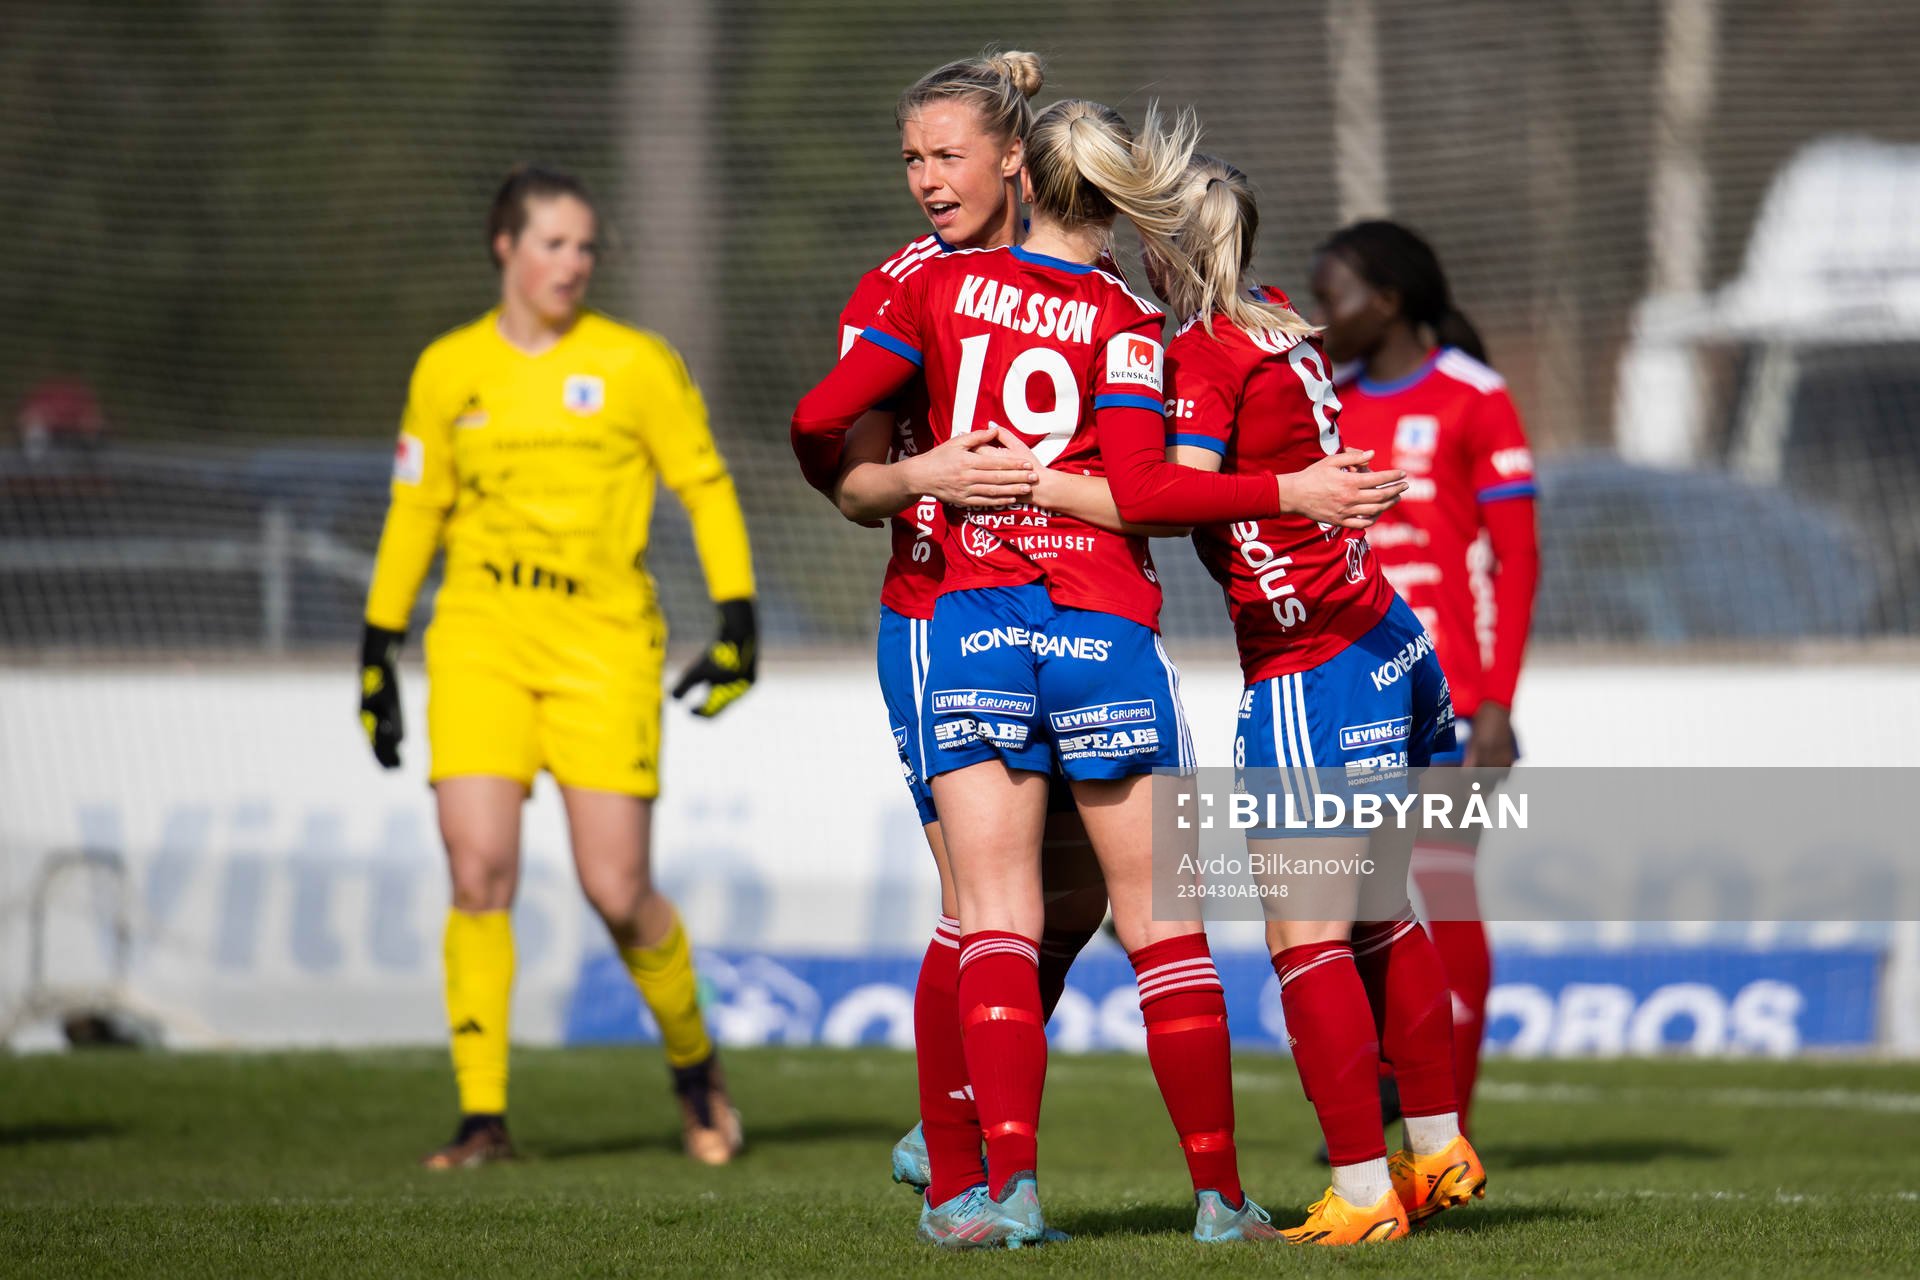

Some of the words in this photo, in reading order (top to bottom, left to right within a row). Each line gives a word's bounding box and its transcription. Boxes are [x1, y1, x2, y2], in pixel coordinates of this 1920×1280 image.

[954, 274, 1098, 345] KARLSSON
[1110, 370, 1149, 381] SVENSKA
[951, 333, 1080, 466] 19
[1288, 340, 1343, 456] 8
[935, 691, 977, 708] LEVINS
[977, 697, 1031, 711] GRUPPEN
[1055, 706, 1108, 728] LEVINS
[1109, 708, 1151, 720] GRUPPEN
[943, 719, 1018, 740] PEAB
[1070, 728, 1149, 750] PEAB
[1344, 721, 1393, 745] LEVINS
[1063, 751, 1097, 760] NORDENS
[1235, 735, 1246, 770] 8
[1358, 751, 1408, 775] PEA
